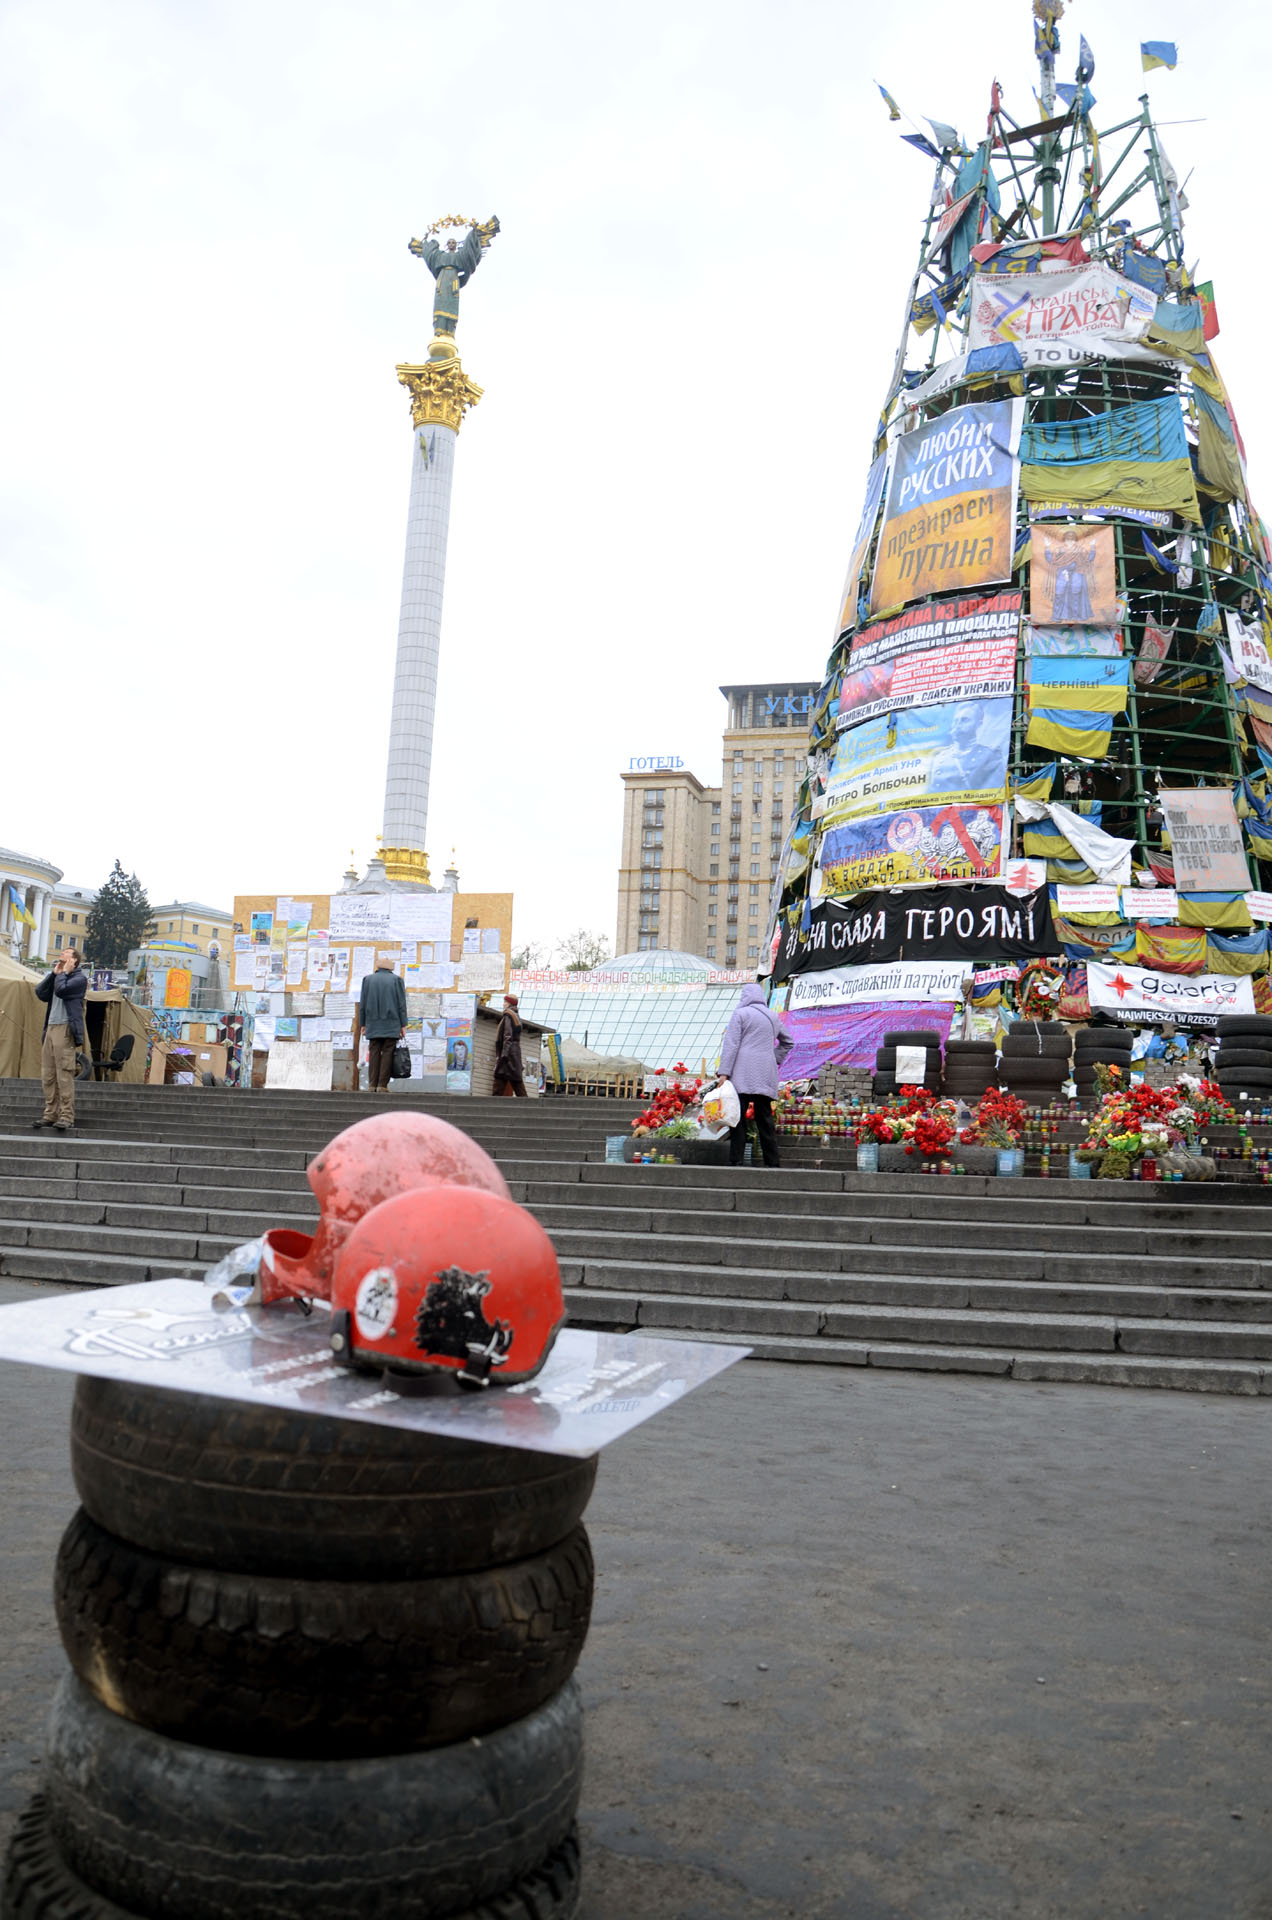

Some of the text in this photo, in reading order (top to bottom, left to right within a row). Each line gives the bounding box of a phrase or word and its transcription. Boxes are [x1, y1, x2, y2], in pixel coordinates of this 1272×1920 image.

[1035, 350, 1061, 362] TO
[899, 446, 996, 506] РУССКИХ
[887, 495, 994, 558] презираем
[885, 607, 932, 635] ПУТИНА
[935, 603, 955, 620] ИЗ
[945, 612, 1019, 634] ПЛОЩАДЬ
[1042, 678, 1100, 690] ЧЕРНІВЦІ
[837, 704, 872, 728] ПОМОЖЕМ
[872, 694, 914, 713] РУССКИМ
[921, 684, 962, 702] СПАСЕМ
[963, 680, 1012, 695] УКРАИНУ
[629, 756, 684, 770] ГОТЕЛЬ
[900, 758, 922, 770] УНР
[843, 857, 894, 881] ВТРАТА
[831, 910, 886, 950] СЛАВА
[572, 970, 629, 984] ЗЛОЧИНЦІВ
[794, 981, 834, 1002] Філарет
[841, 969, 902, 998] справжній
[1141, 977, 1237, 998] galeria
[1117, 1010, 1220, 1026] NAJWIĘKSZA W RZESZO
